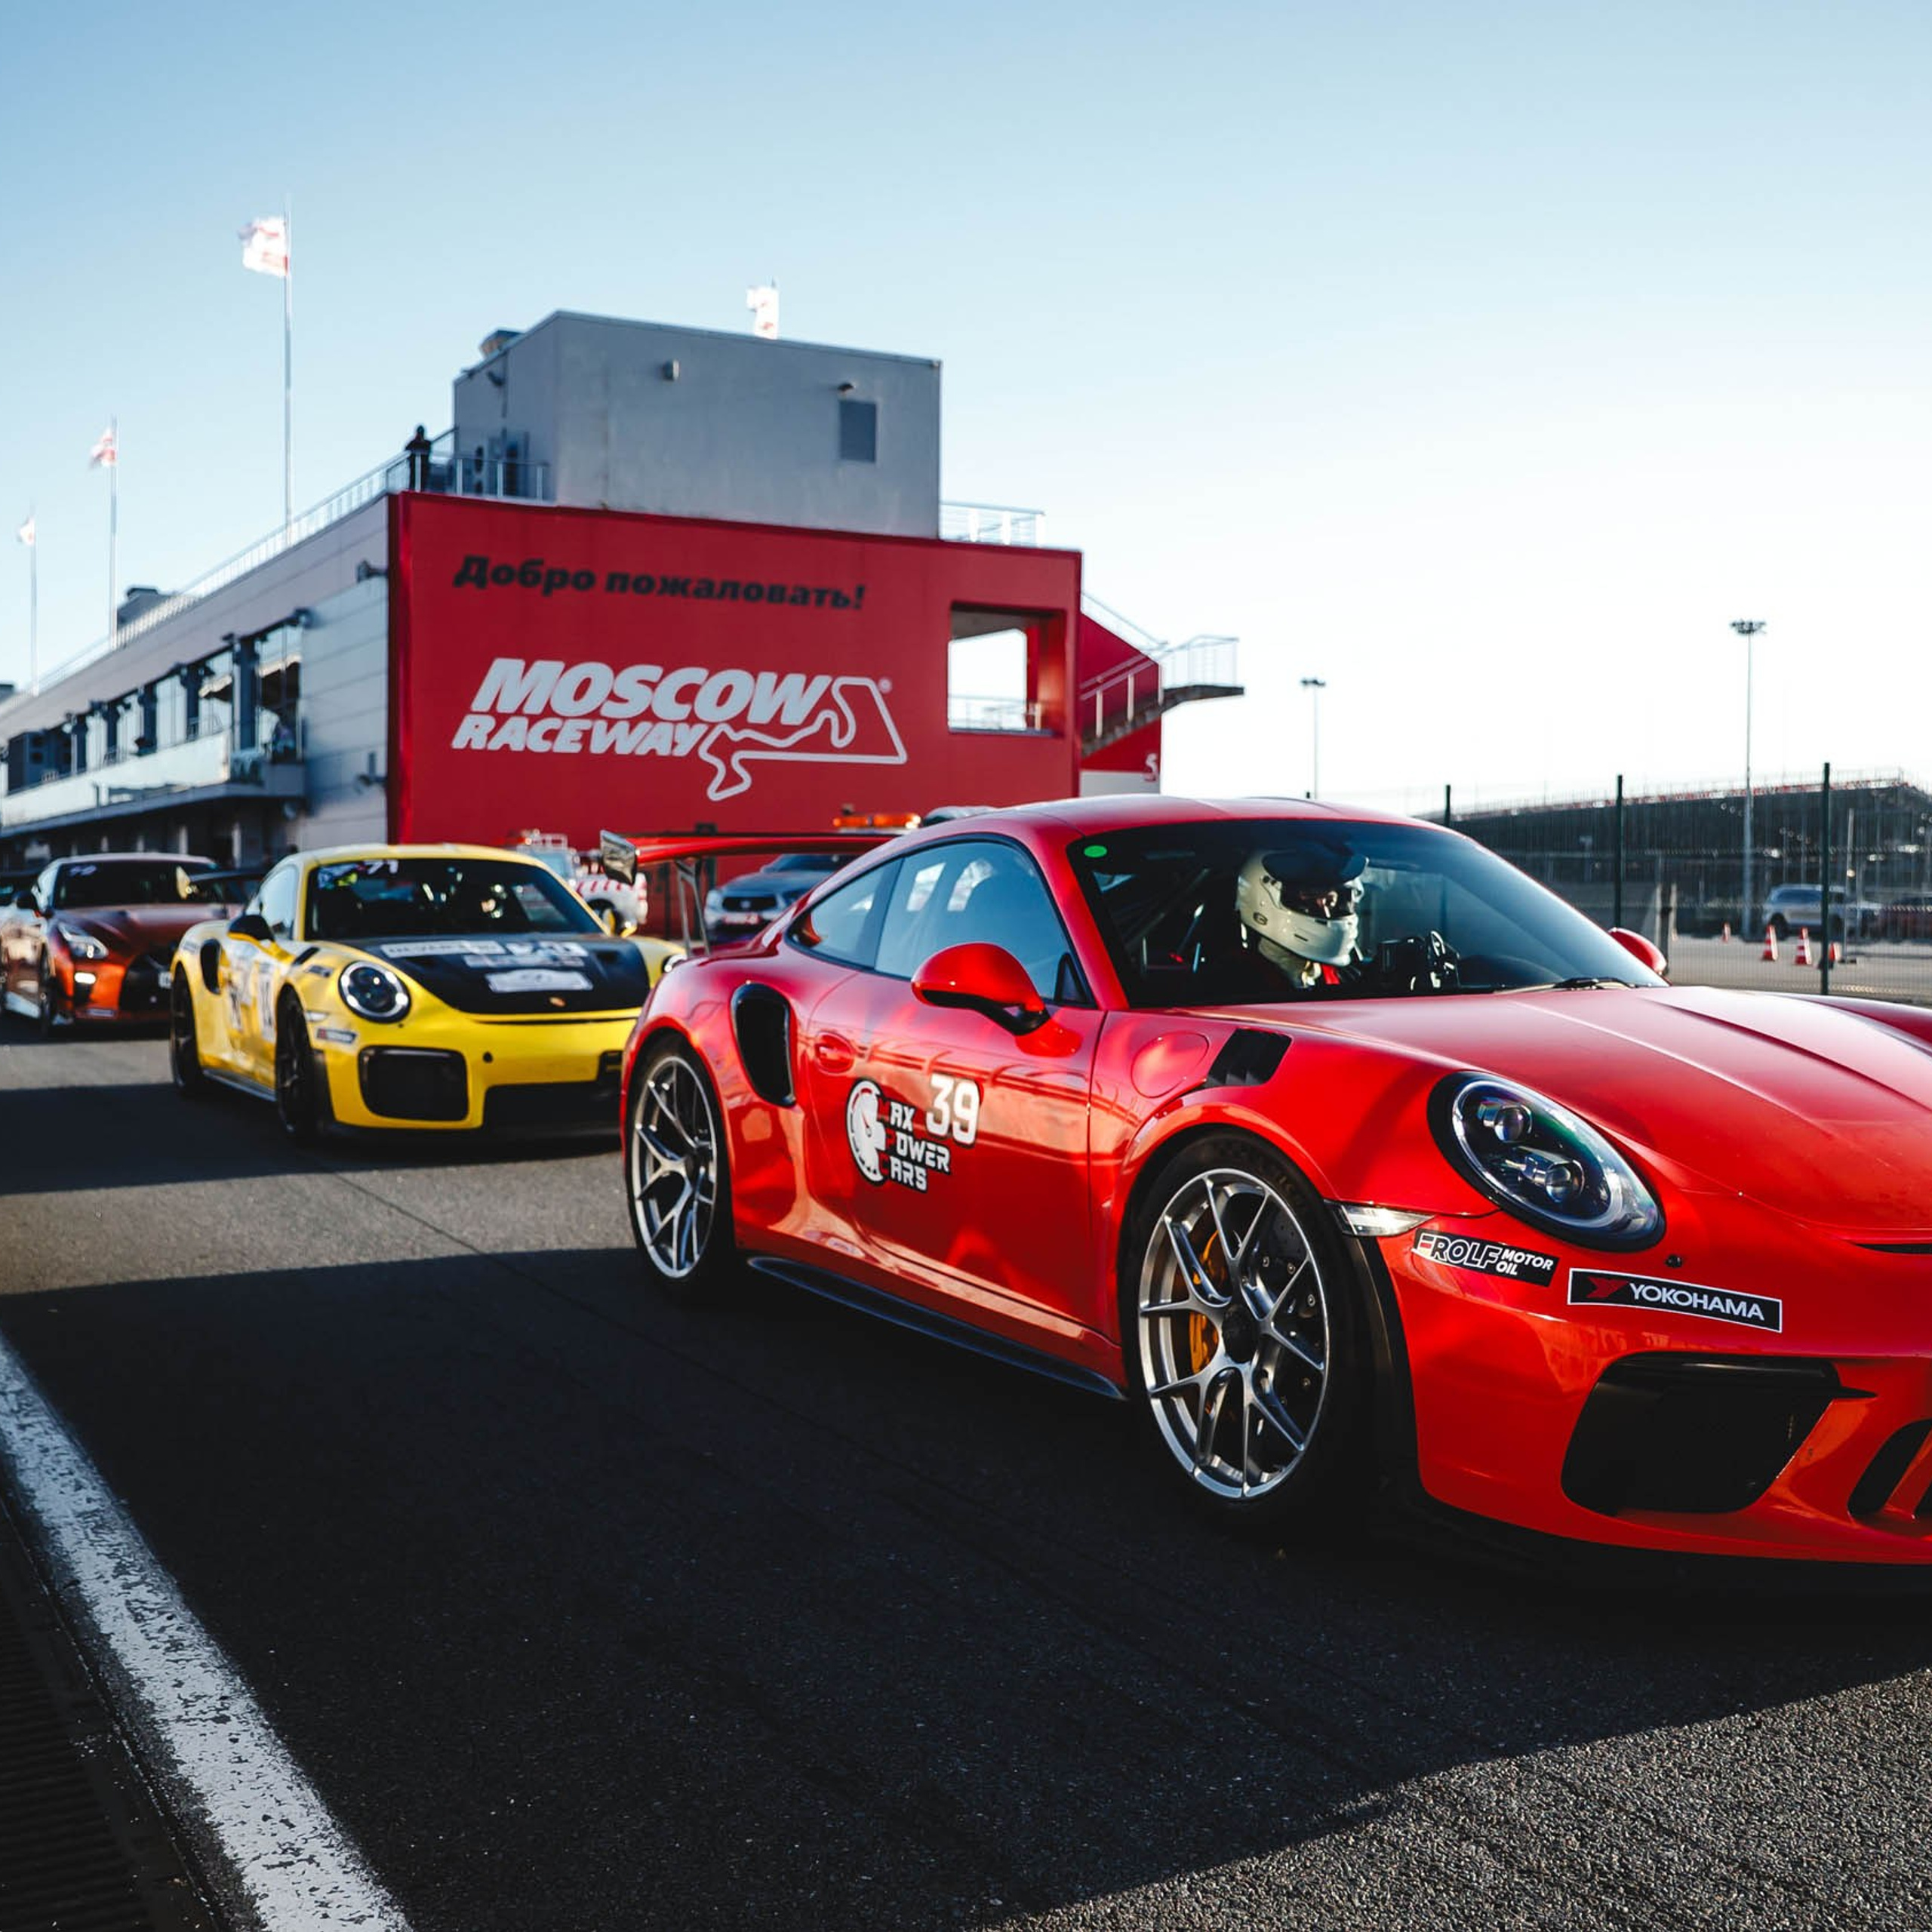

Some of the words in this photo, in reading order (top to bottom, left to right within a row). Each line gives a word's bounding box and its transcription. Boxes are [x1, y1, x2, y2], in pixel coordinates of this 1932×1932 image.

[453, 554, 596, 597] Добро
[605, 571, 865, 611] пожаловать!
[470, 657, 832, 724] MOSCOW
[451, 714, 709, 758] RACEWAY
[926, 1072, 980, 1145] 39
[1429, 1234, 1503, 1269] ROLF
[1500, 1249, 1554, 1271] MOTOR
[1495, 1261, 1518, 1276] OIL
[1629, 1282, 1765, 1321] YOKOHAMA
